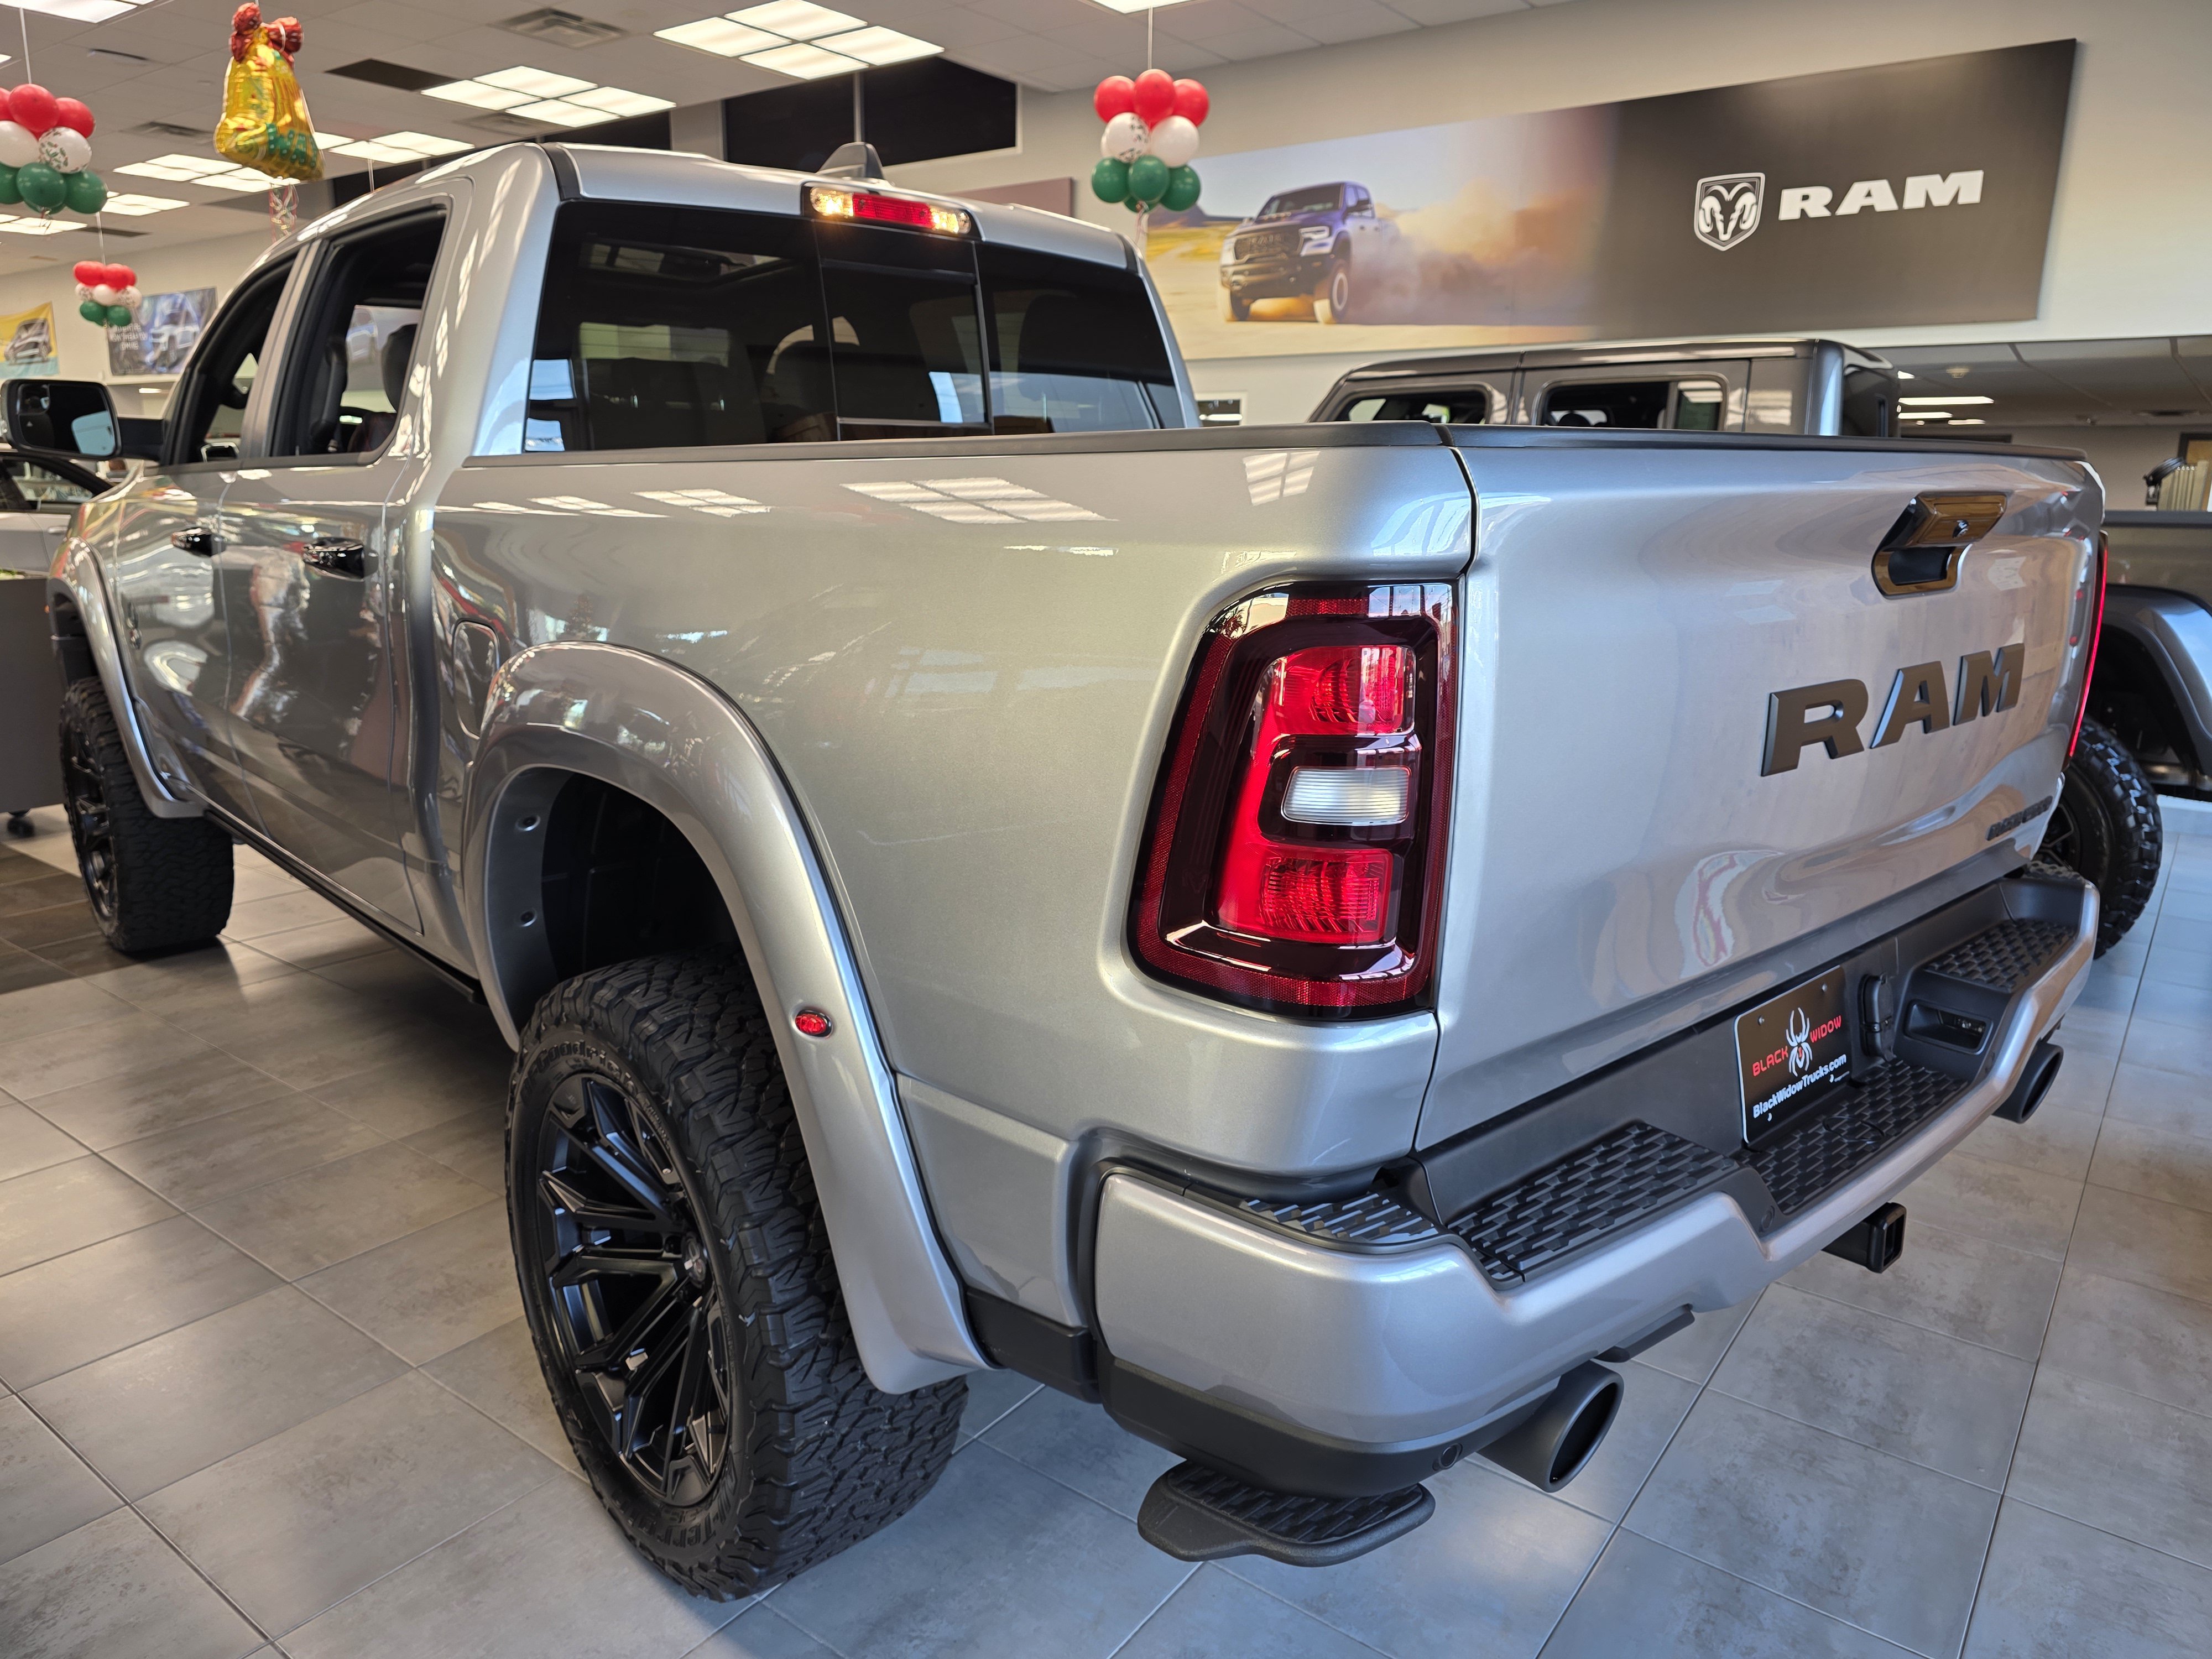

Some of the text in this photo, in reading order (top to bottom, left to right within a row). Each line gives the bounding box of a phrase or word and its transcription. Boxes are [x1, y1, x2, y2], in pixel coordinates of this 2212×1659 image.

[1778, 170, 1984, 221] RAM
[1760, 643, 2025, 778] RAM
[1752, 1015, 1842, 1076] BLACK WIDOW
[1752, 1054, 1847, 1118] BlackWidowTrucks.com
